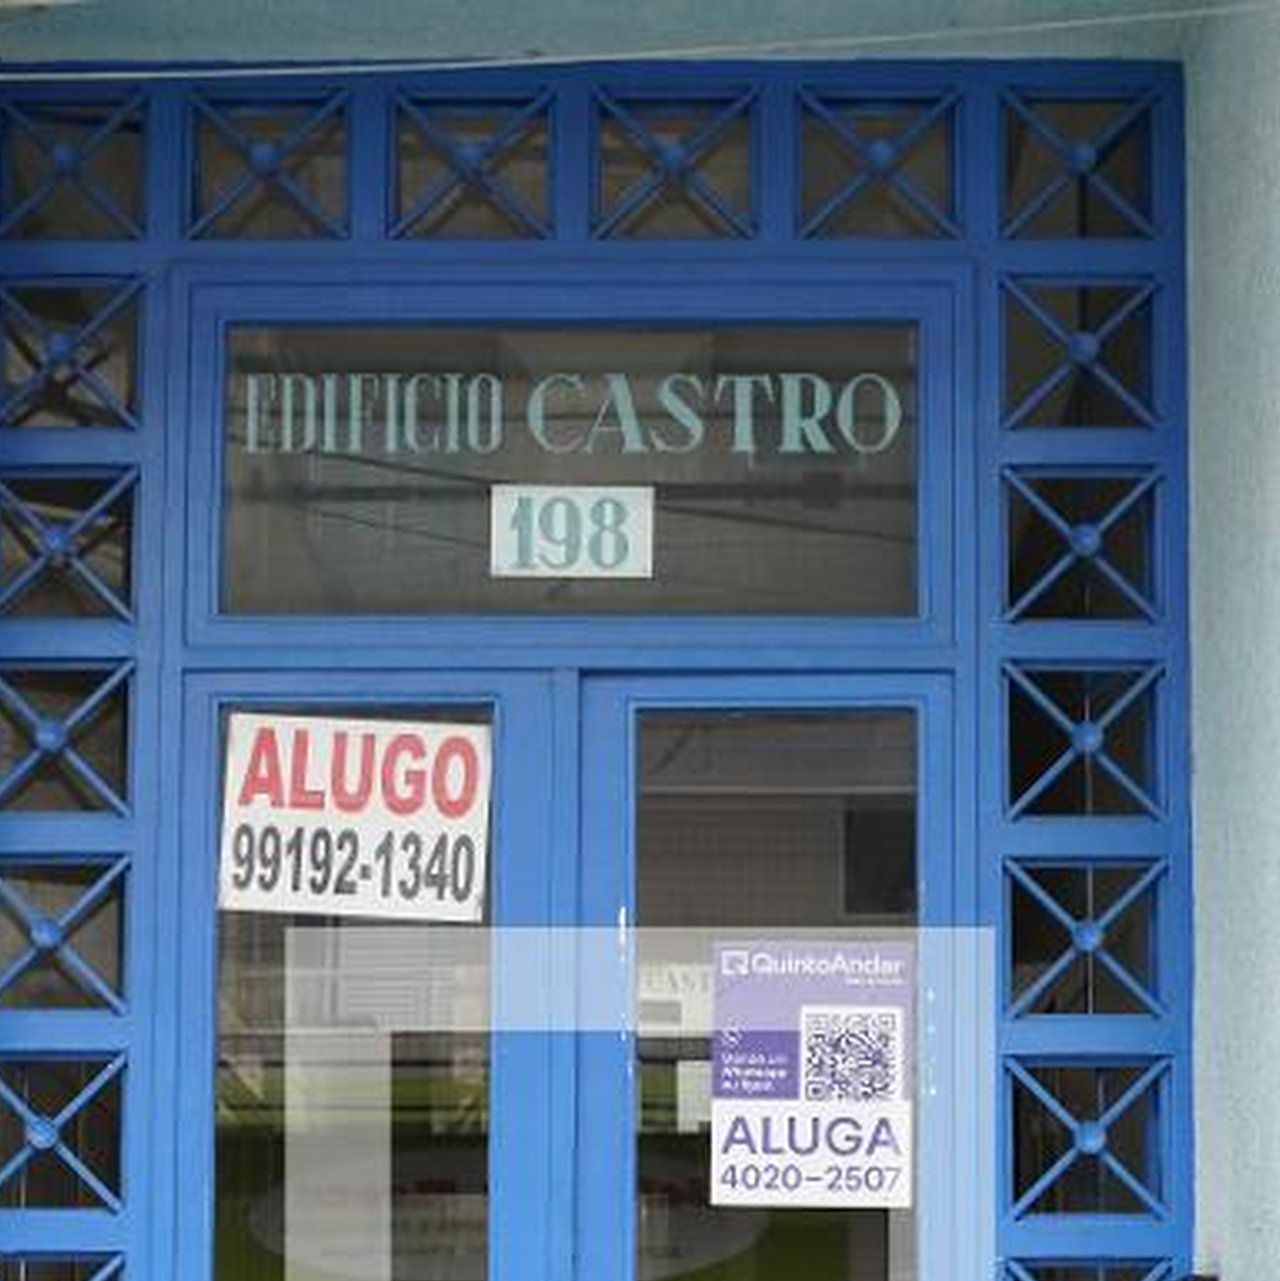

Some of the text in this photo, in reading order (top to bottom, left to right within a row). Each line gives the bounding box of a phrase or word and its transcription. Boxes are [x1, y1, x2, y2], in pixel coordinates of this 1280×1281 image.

[244, 371, 904, 455] EDIFICIO CASTRO
[508, 495, 631, 572] 198
[236, 725, 481, 820] ALUGO
[230, 822, 476, 902] 99192-1340
[750, 951, 905, 976] QuintoAndar
[720, 1115, 902, 1157] ALUGA
[720, 1163, 903, 1192] 4020-2507
